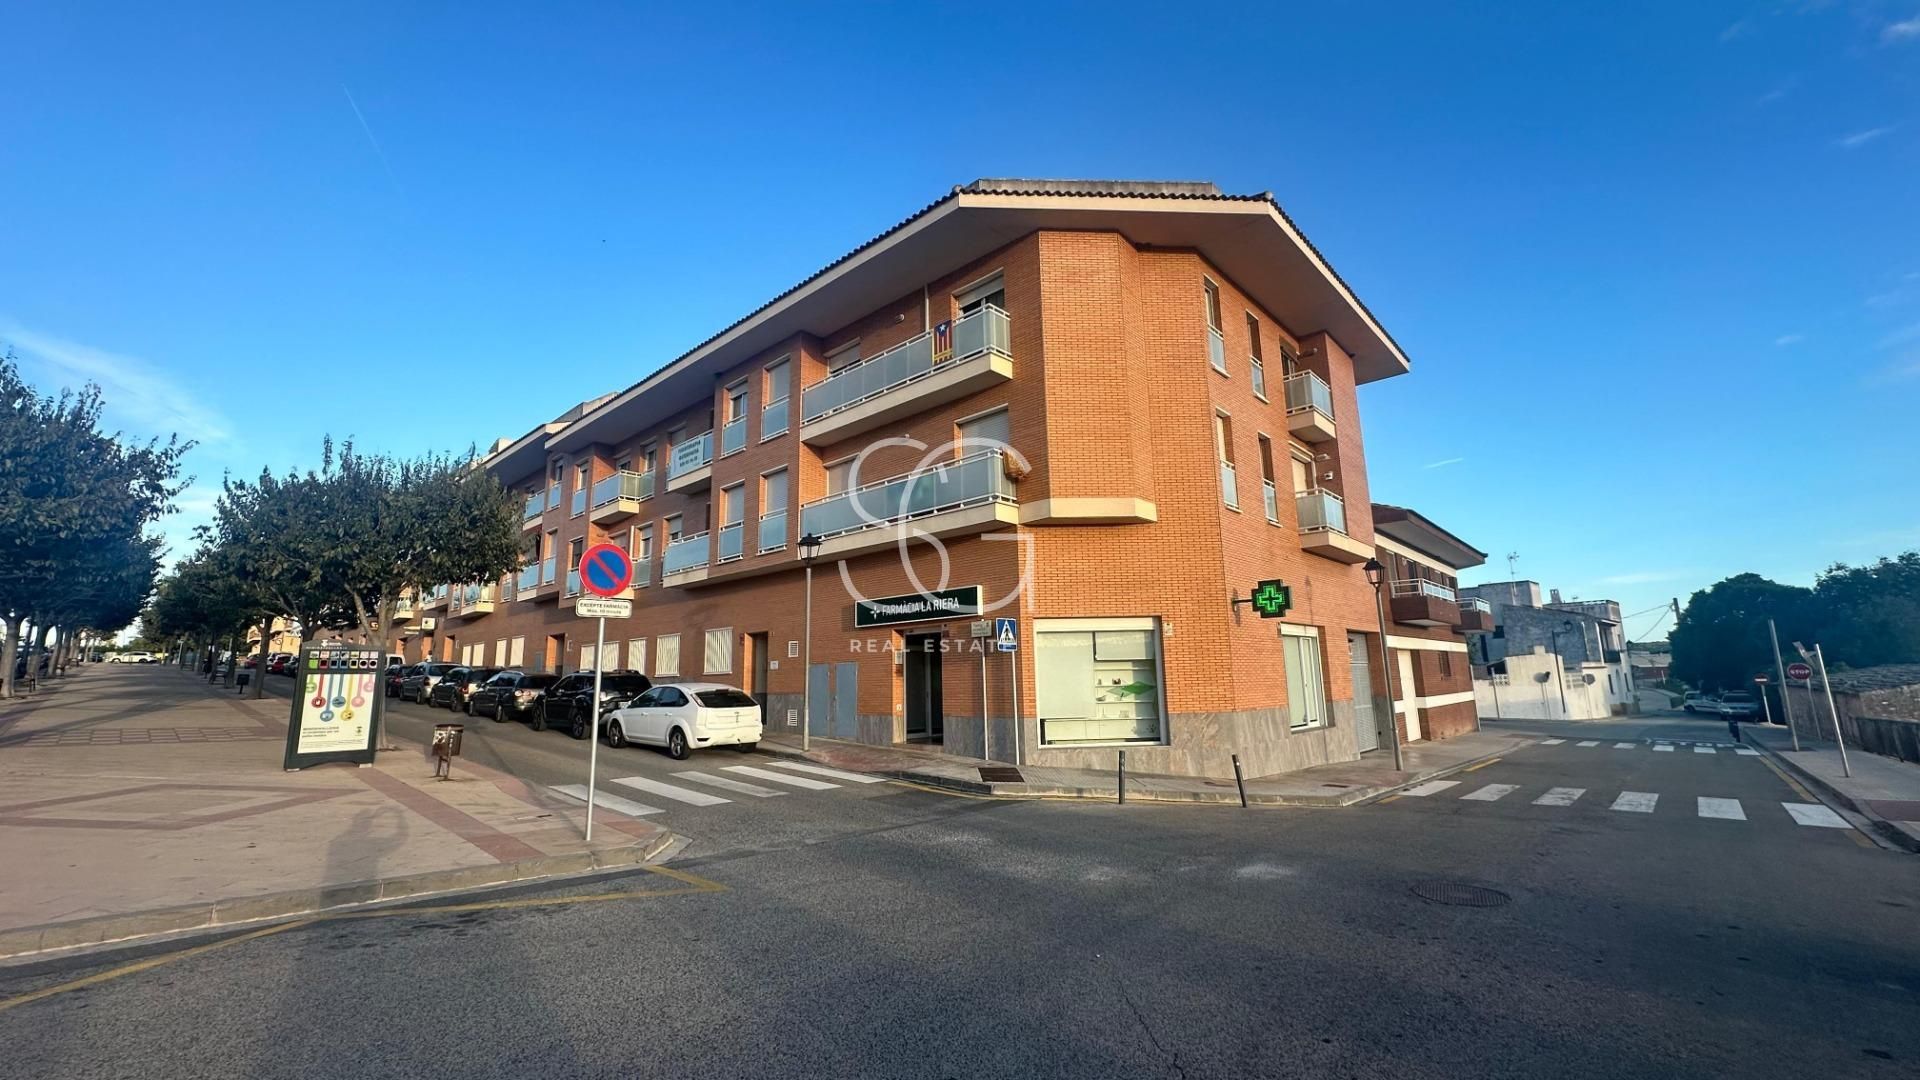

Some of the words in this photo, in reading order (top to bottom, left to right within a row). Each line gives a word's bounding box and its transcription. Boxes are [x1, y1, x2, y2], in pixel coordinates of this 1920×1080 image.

[882, 601, 919, 616] FARMÀCIA
[921, 600, 932, 612] LA
[933, 597, 960, 610] RIERA
